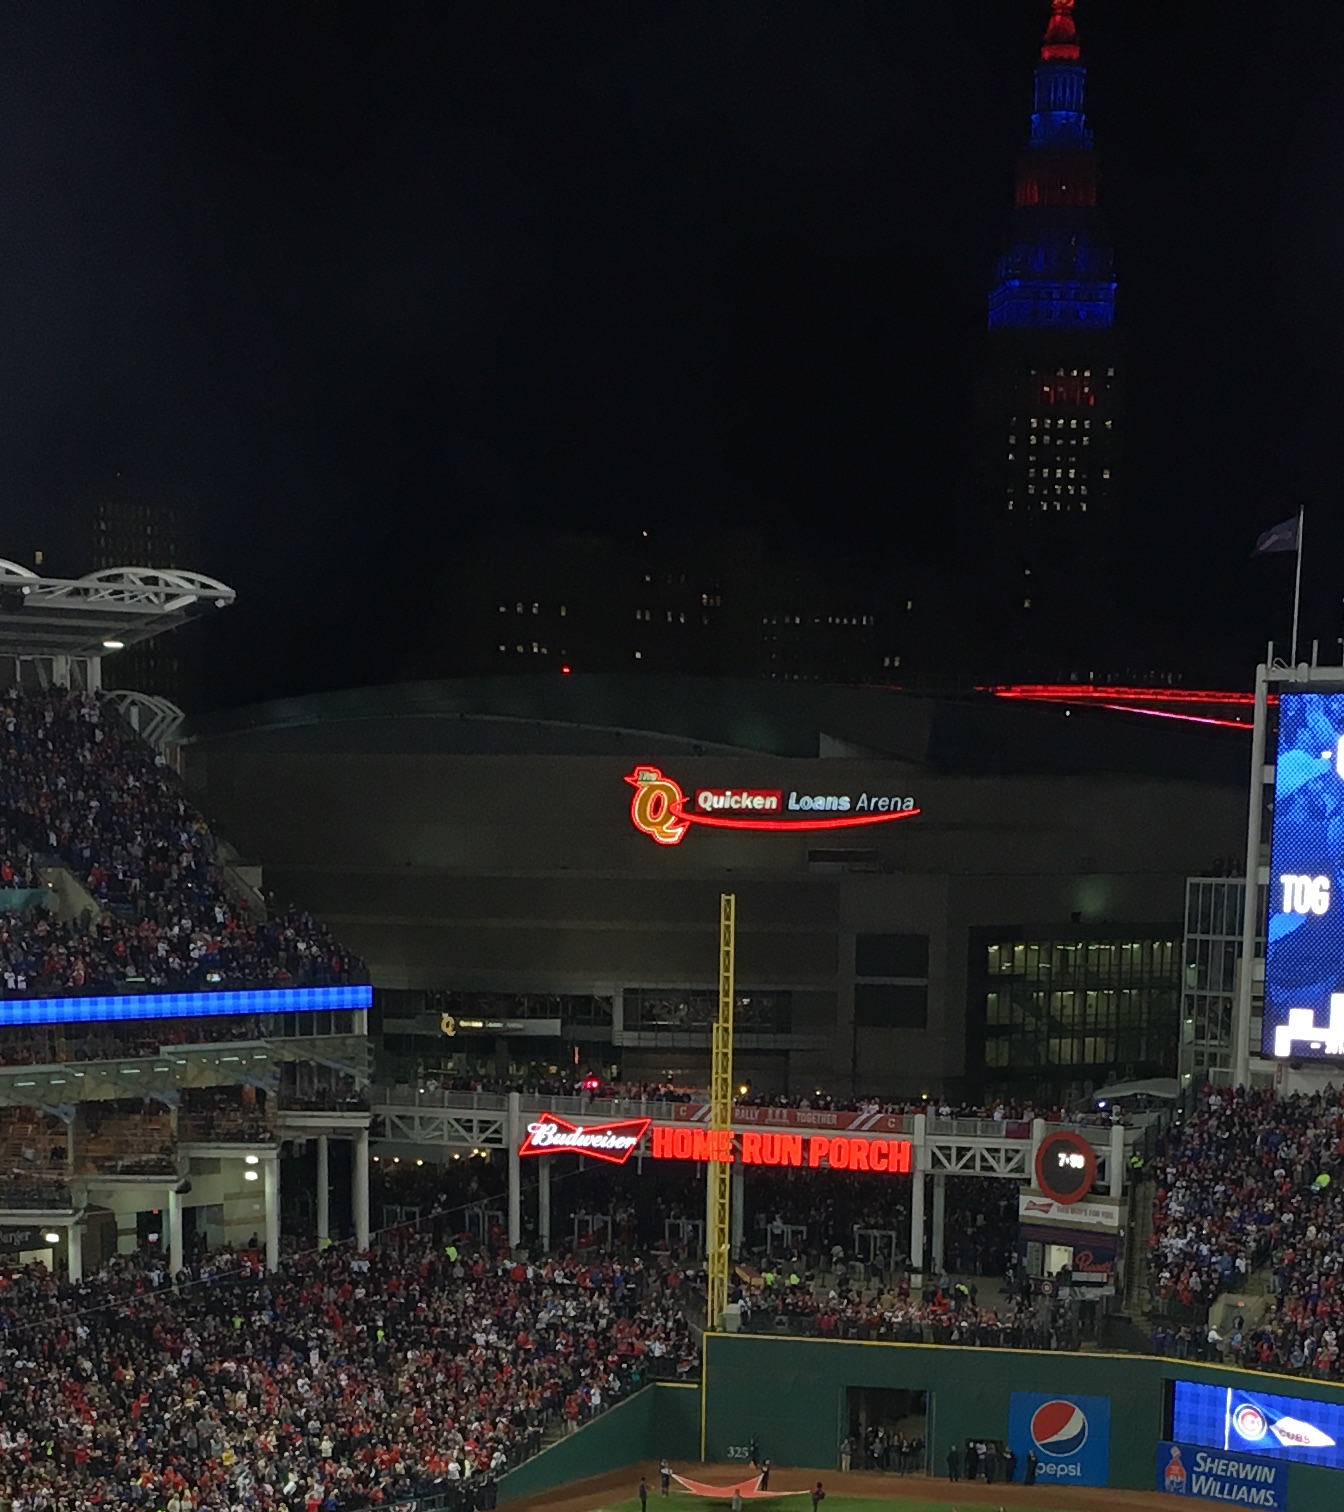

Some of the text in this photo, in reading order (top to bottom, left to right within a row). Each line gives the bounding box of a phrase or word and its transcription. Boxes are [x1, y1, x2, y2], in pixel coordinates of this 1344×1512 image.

[697, 791, 915, 812] Quicken Loans Arena
[1280, 873, 1330, 915] TOG
[734, 1108, 838, 1125] RALLY TOGETHER
[527, 1122, 638, 1149] Budweiser
[742, 1131, 803, 1167] RUN
[809, 1135, 912, 1174] PORCH
[727, 1445, 749, 1459] 325
[1036, 1462, 1081, 1477] pepsi
[1193, 1451, 1276, 1484] SHERWIN
